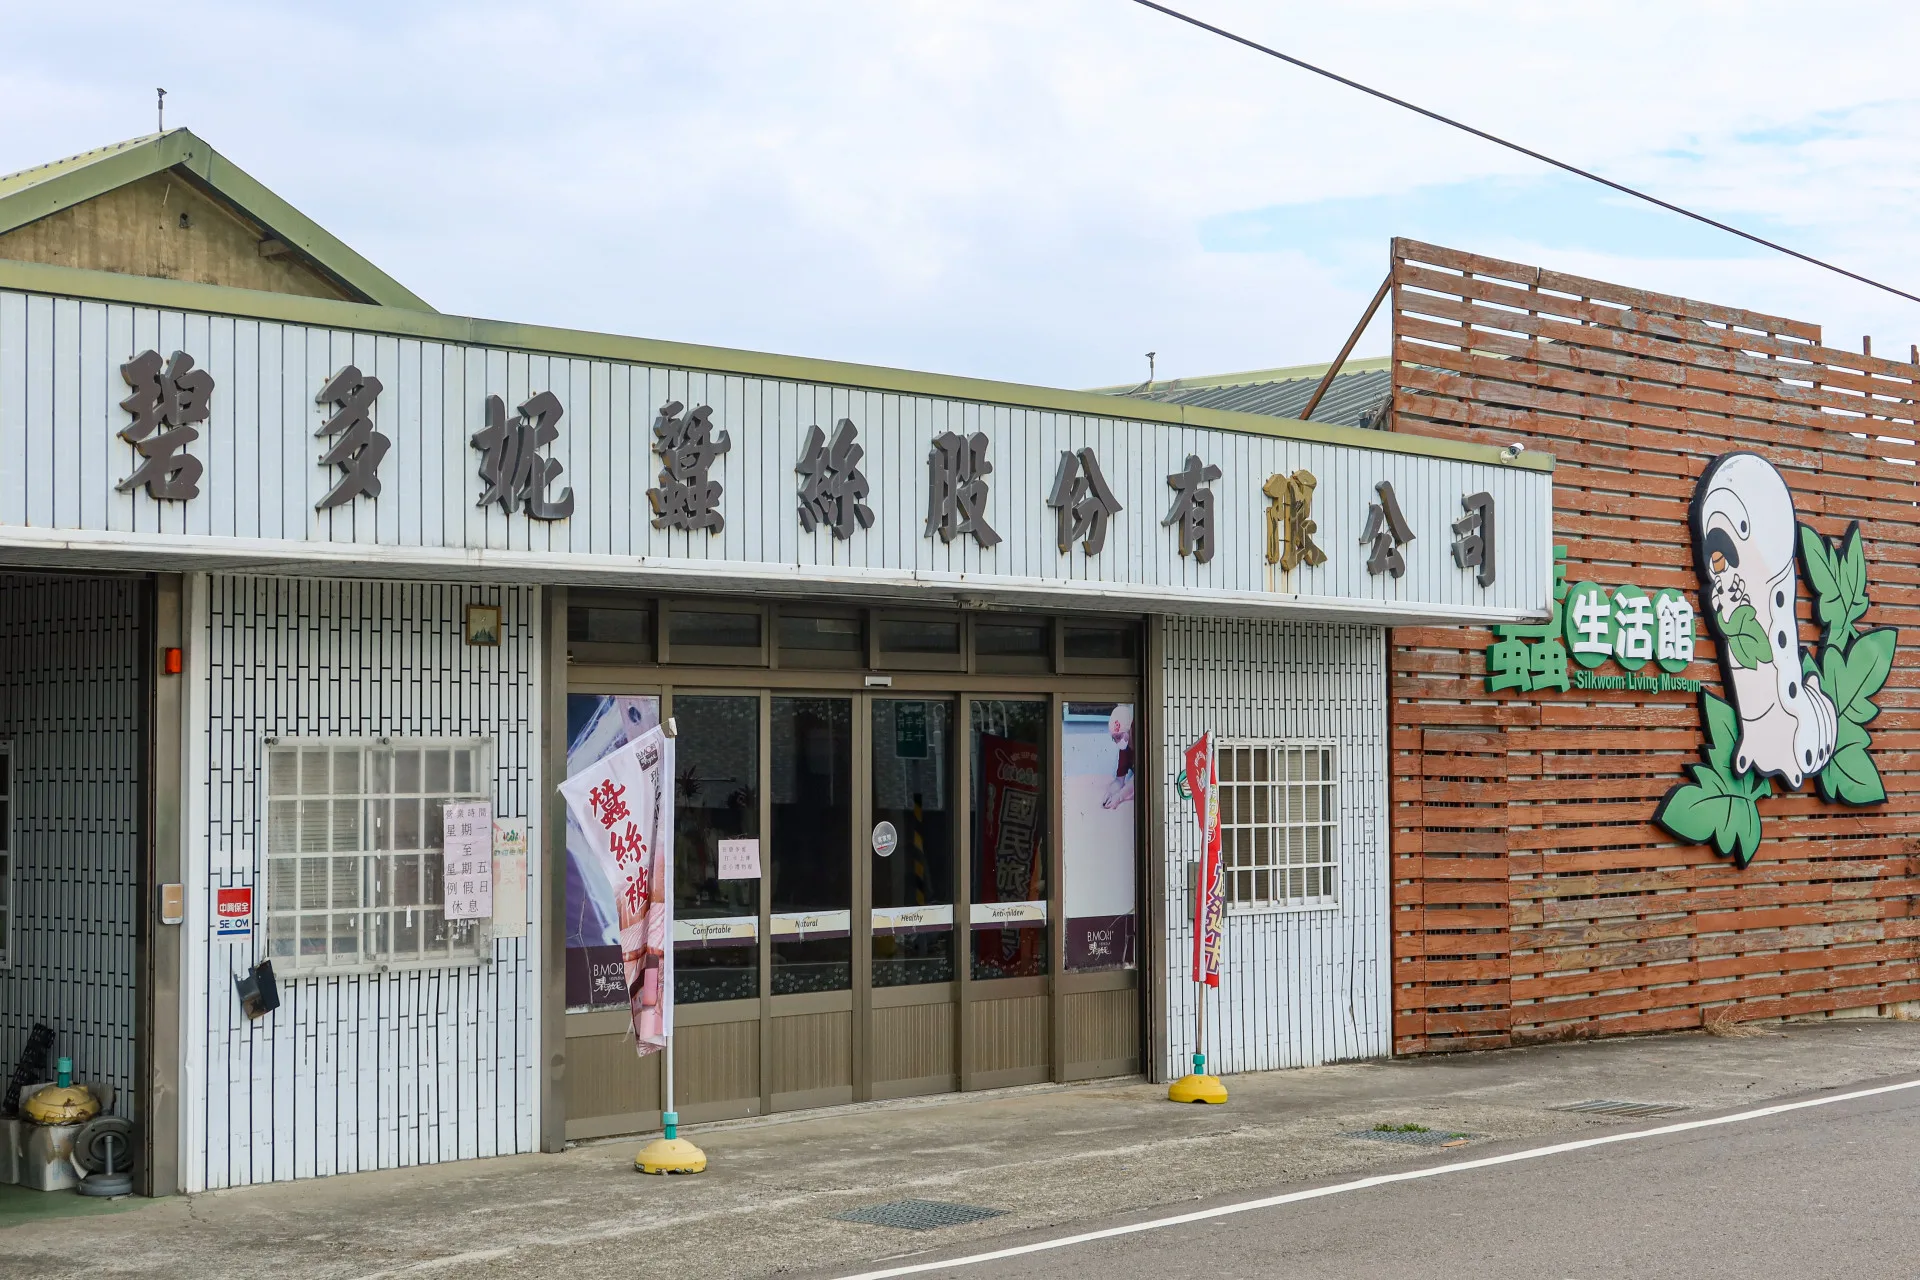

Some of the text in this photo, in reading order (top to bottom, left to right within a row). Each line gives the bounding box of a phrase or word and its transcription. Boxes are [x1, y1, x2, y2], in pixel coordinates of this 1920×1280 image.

[1572, 590, 1694, 662] 生活館
[1575, 670, 1701, 694] Silkworm Living Museum
[445, 807, 487, 819] 營業時間
[446, 823, 488, 838] 星期一
[462, 843, 472, 857] 至
[589, 778, 649, 916] 蠶絲被
[446, 861, 488, 876] 星期五
[446, 880, 488, 896] 例假日
[219, 902, 249, 913] 中興保全
[452, 900, 479, 914] 休息
[219, 919, 249, 929] SECOM
[794, 920, 818, 929] Natural
[901, 914, 924, 923] Healthy
[692, 925, 732, 935] Comfortable
